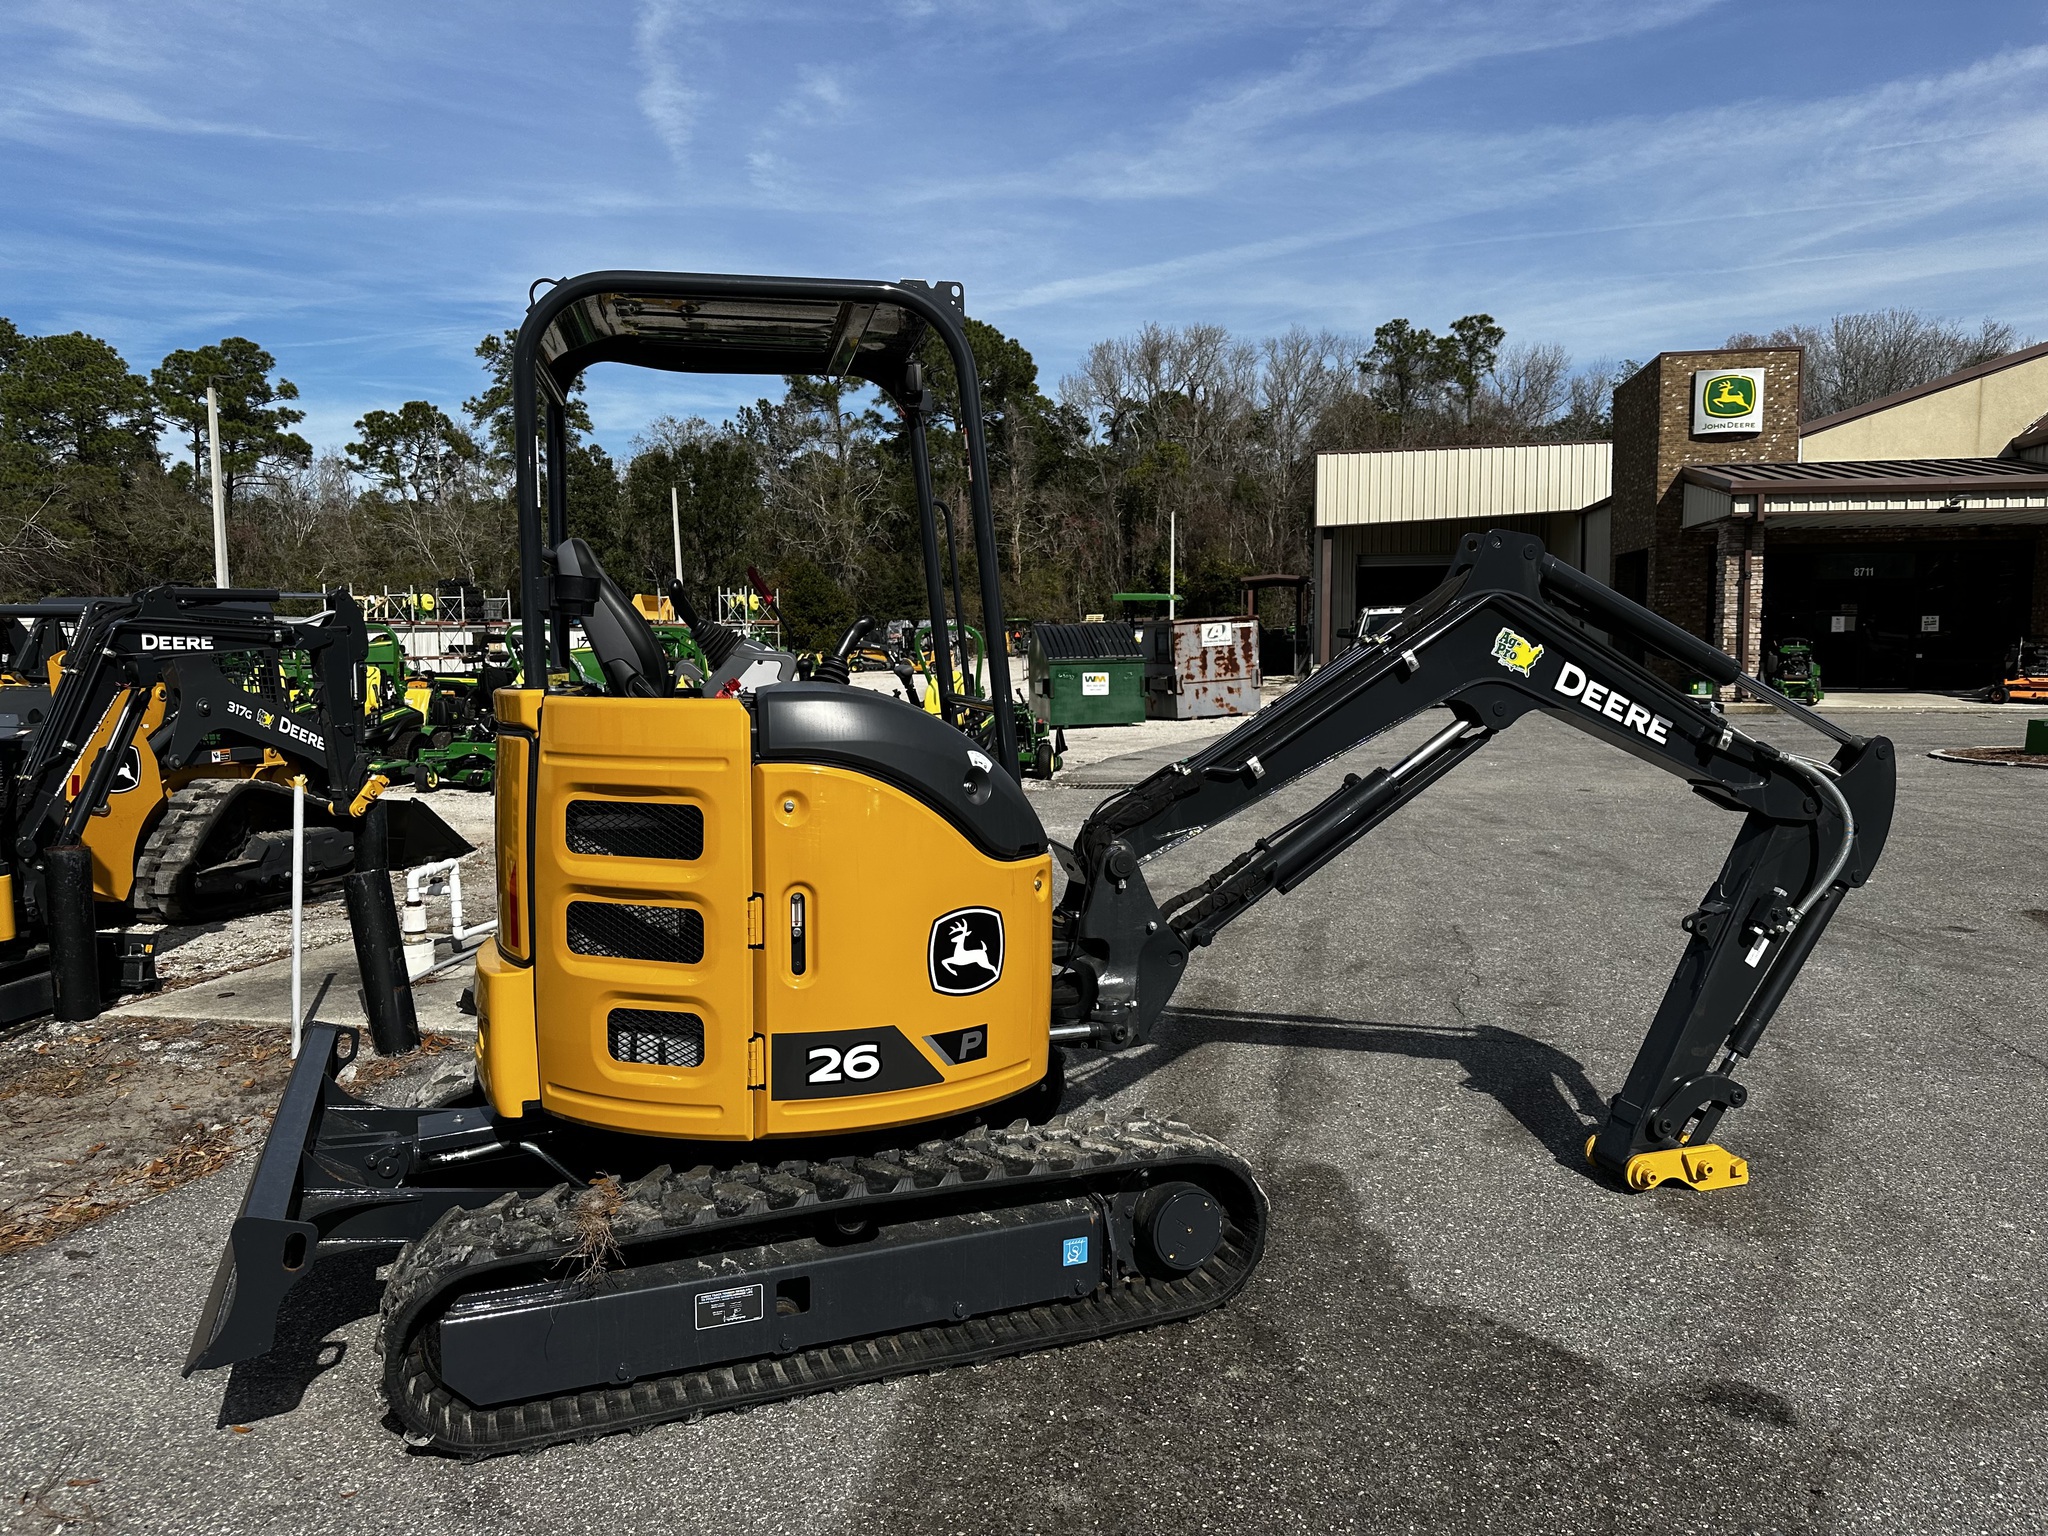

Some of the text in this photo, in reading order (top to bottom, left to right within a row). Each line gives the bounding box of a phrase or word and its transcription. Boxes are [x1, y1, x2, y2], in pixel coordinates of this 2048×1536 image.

[1701, 421, 1756, 431] JOHN DEERE
[1853, 567, 1874, 577] 8711
[141, 633, 214, 650] DEERE
[1494, 642, 1518, 660] Pro
[1084, 675, 1106, 683] WM
[226, 701, 253, 720] 317G
[1554, 661, 1674, 745] DEERE
[278, 716, 326, 751] DEERE
[808, 1030, 983, 1083] 26 P
